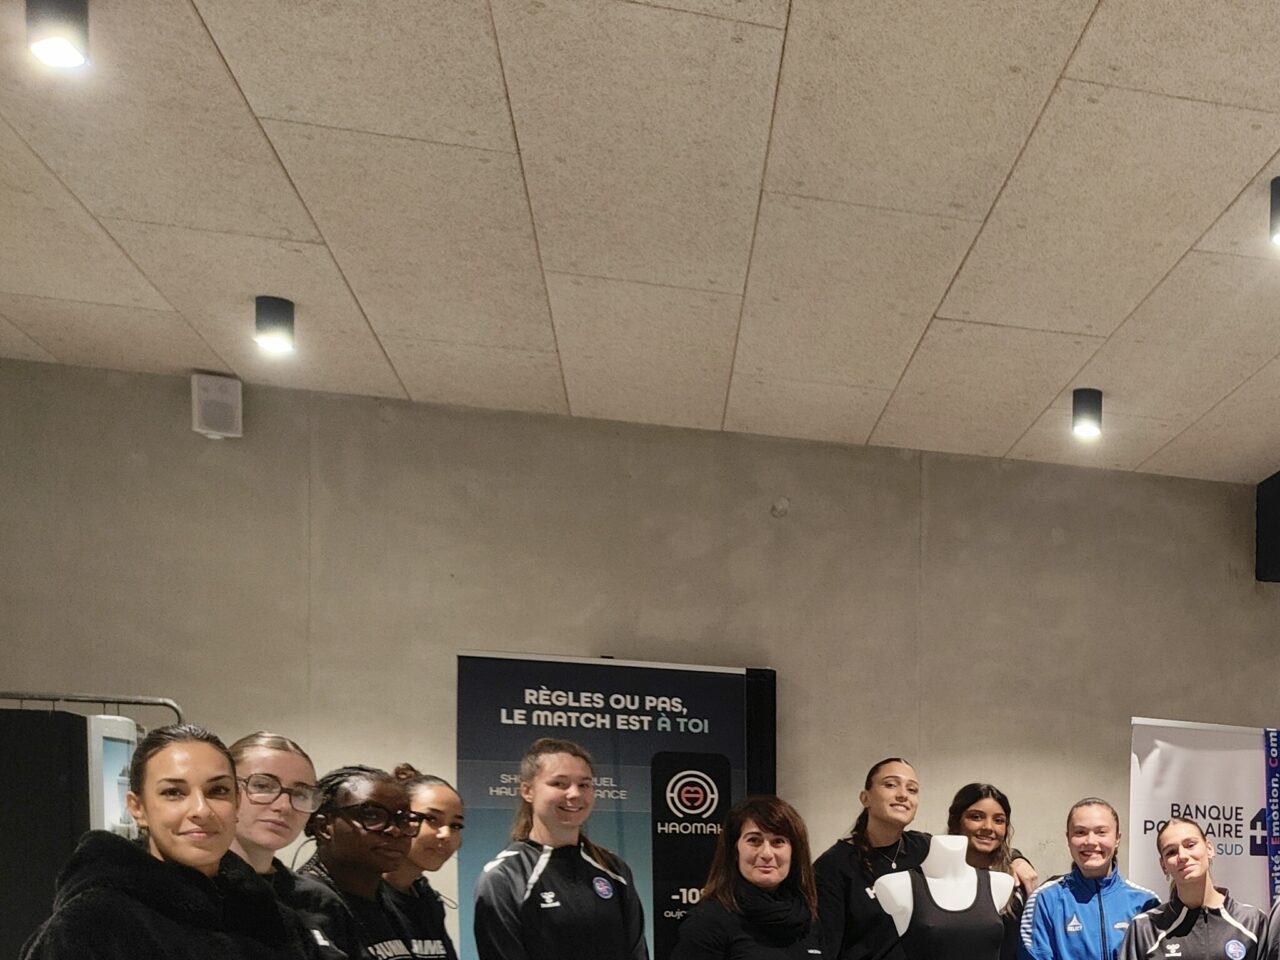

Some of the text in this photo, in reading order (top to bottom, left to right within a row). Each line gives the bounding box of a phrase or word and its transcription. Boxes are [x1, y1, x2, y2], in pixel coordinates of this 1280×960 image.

[524, 686, 688, 715] RÈGLES OU PAS,
[501, 708, 709, 733] LE MATCH EST À TOI
[1171, 803, 1244, 821] BANQUE
[1270, 773, 1280, 845] Emotion,
[1216, 843, 1244, 856] SUD
